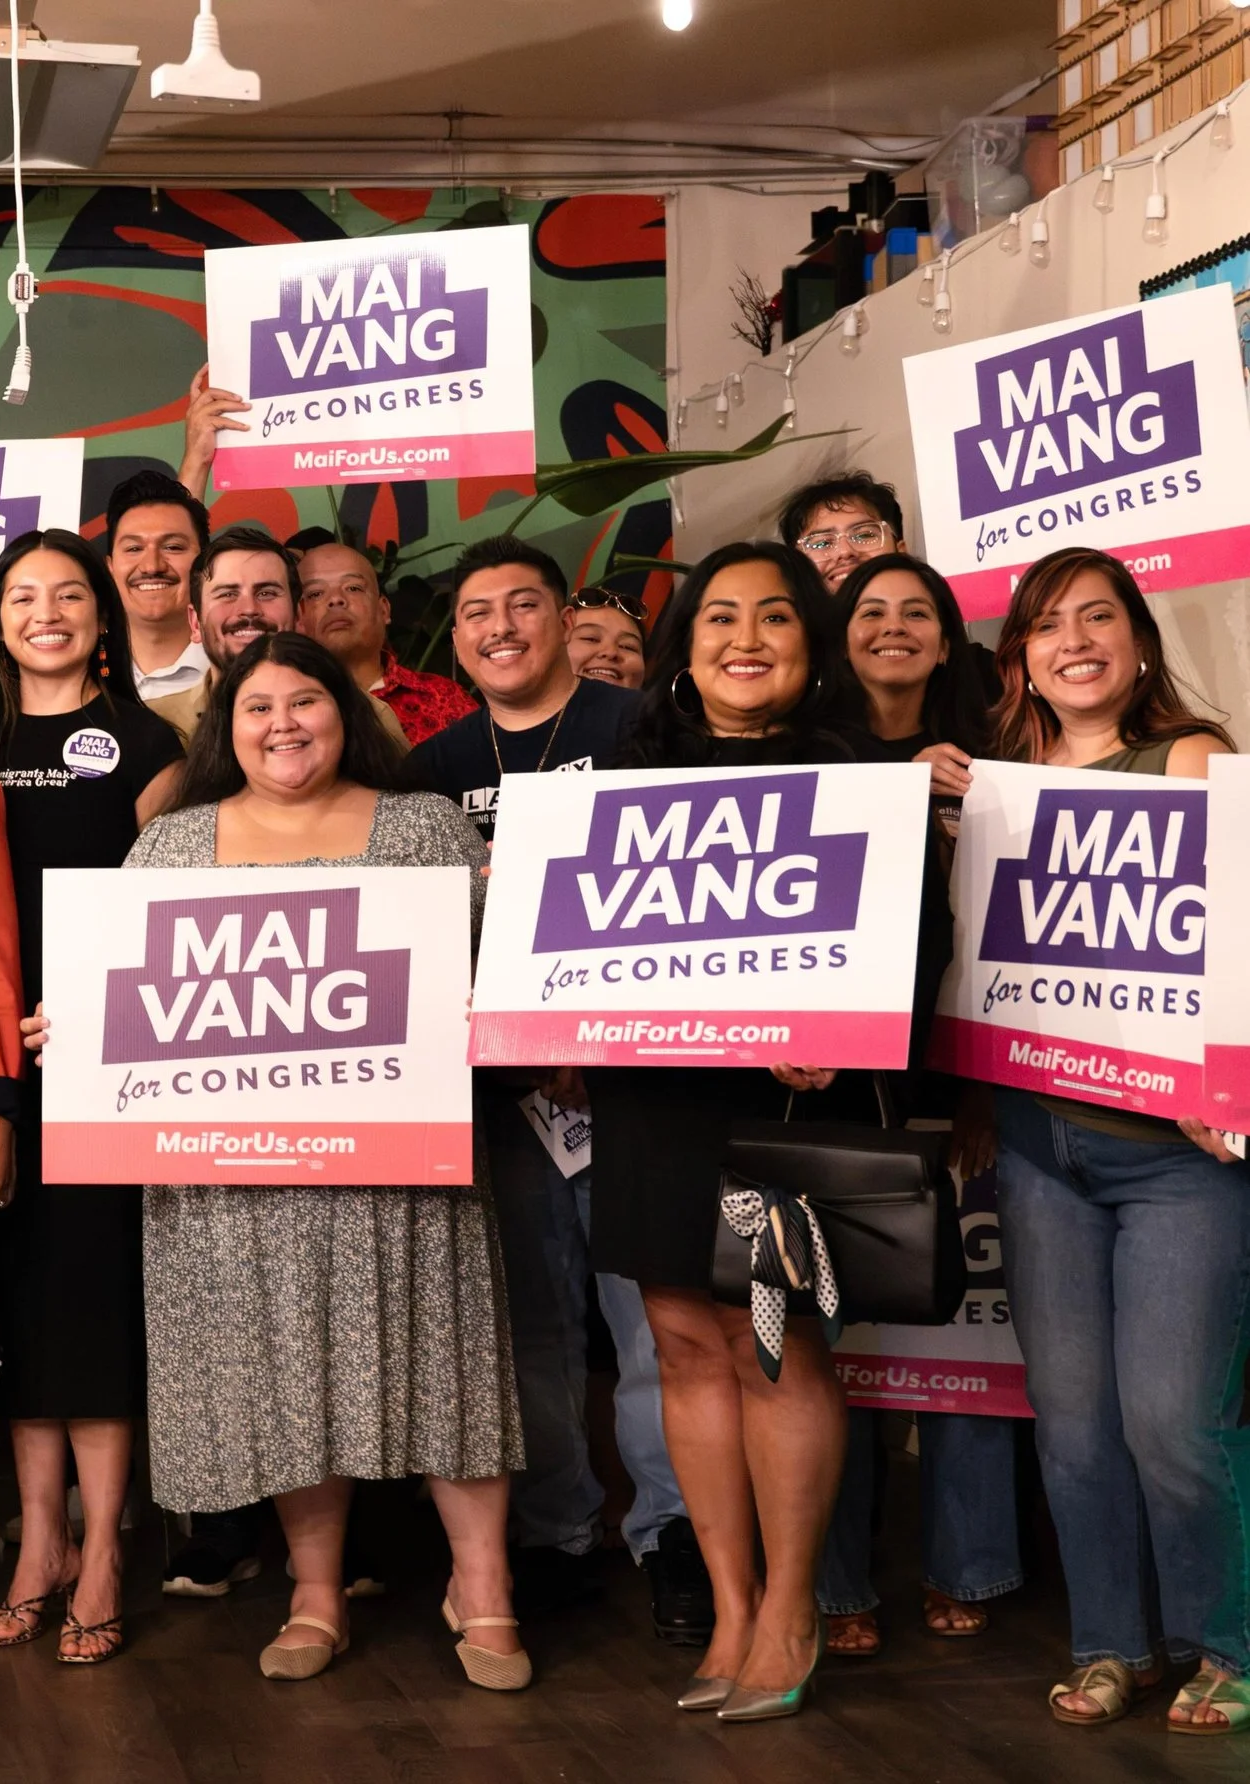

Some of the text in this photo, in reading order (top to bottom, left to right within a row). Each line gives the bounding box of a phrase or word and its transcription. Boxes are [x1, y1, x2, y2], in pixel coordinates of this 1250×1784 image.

[301, 258, 422, 325] MAI
[275, 308, 456, 379] VANG
[262, 379, 484, 438] for CONGRESS
[997, 336, 1122, 429] MAI
[294, 447, 450, 469] MaiForUs.com
[978, 391, 1166, 493] VANG
[975, 469, 1202, 562] for CONGRESS
[75, 743, 111, 757] VANG
[80, 735, 107, 747] MAI
[35, 777, 68, 787] Great
[46, 768, 77, 780] Make
[613, 792, 782, 865] MAI
[1047, 810, 1185, 878] MAI
[576, 854, 818, 931] VANG
[1018, 879, 1206, 955] VANG
[172, 907, 327, 977] MAI
[541, 944, 848, 1002] for CONGRESS
[983, 969, 1201, 1016] for CONGRES
[137, 969, 369, 1043] VANG
[576, 1020, 790, 1044] MaiForUs.com
[116, 1057, 402, 1113] for CONGRESS
[1008, 1040, 1175, 1095] MaiForUs.com
[155, 1131, 355, 1154] MaiForUs.com
